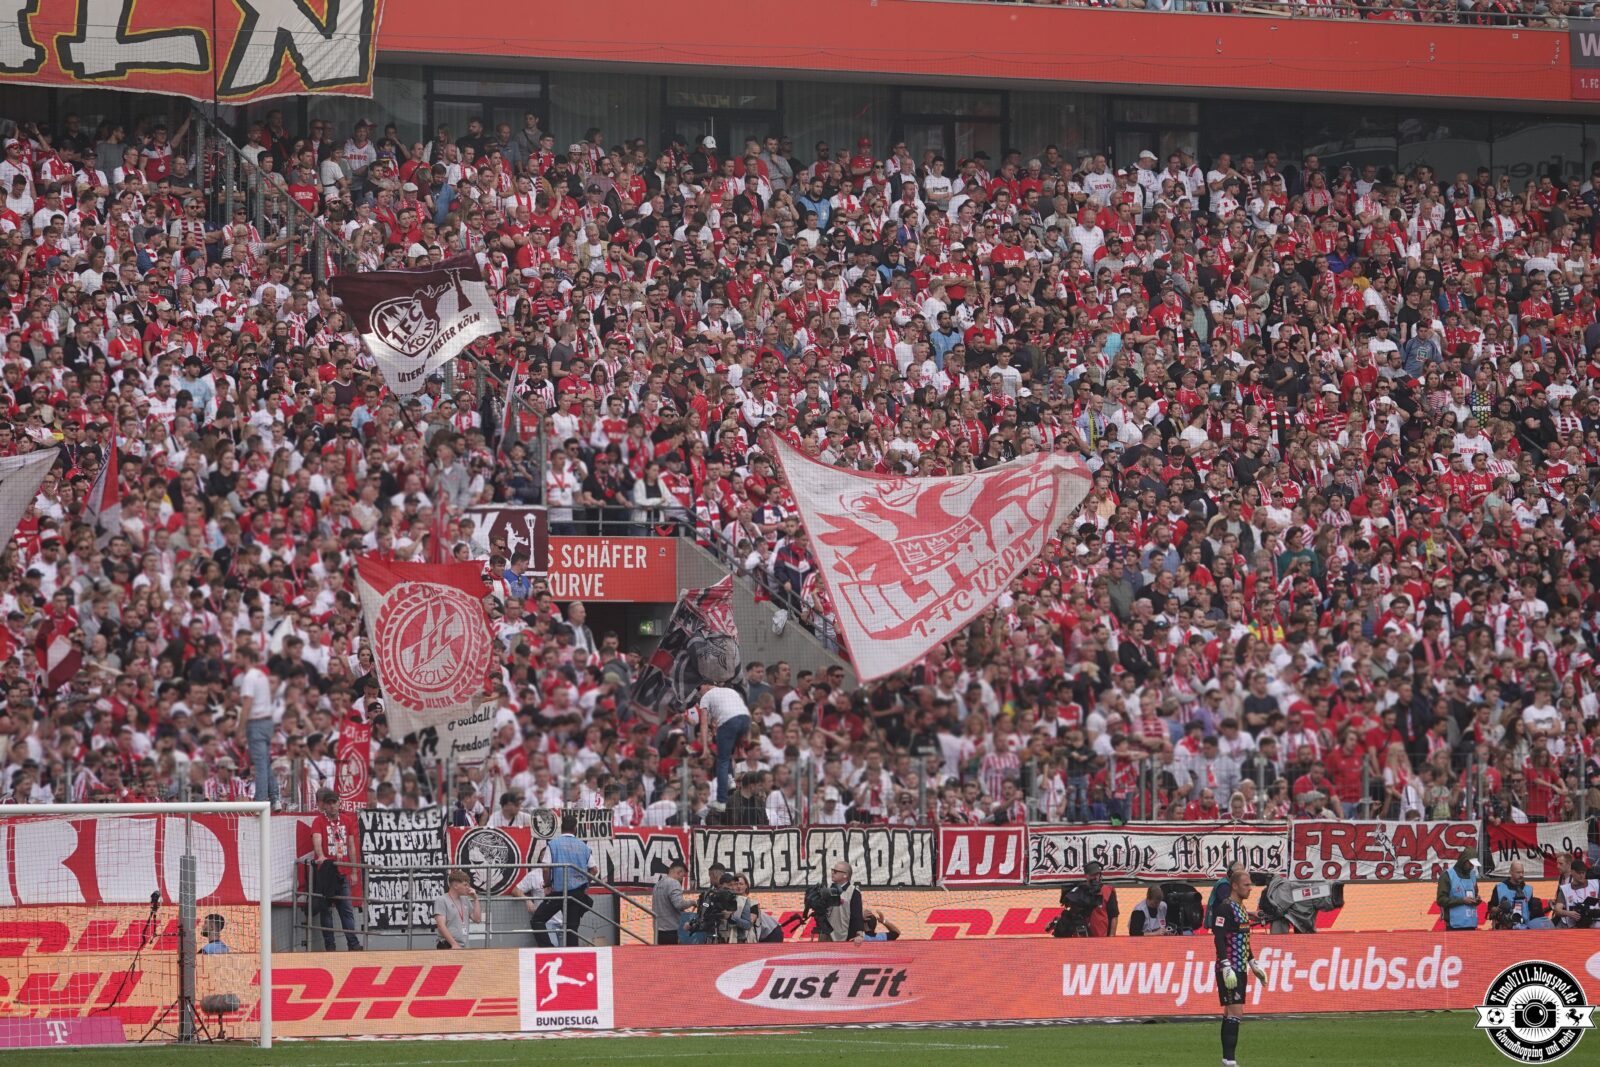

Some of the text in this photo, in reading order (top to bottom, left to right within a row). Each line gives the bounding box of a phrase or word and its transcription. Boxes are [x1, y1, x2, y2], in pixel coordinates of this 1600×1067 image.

[458, 312, 481, 331] KÖLN
[407, 320, 434, 352] KÖLN
[561, 540, 647, 568] SCHÄFER
[838, 500, 1033, 638] ULTRA
[450, 736, 490, 758] freedom
[360, 808, 442, 830] VIRAGE
[362, 830, 442, 851] AUTEUIL
[1294, 823, 1477, 861] FREAKS
[1498, 839, 1520, 862] NA
[946, 835, 1017, 875] AJJ
[1030, 834, 1283, 880] Kölsche Mythos
[1294, 861, 1448, 881] COLOGN
[368, 879, 445, 901] OSMOPLITES
[738, 967, 907, 1000] Just Fit
[1062, 945, 1463, 1006] www.jufit-clubs.de
[0, 970, 158, 1024] HL
[250, 965, 476, 1021] DHL
[47, 1020, 68, 1043] T
[536, 1016, 599, 1026] BUNDESLIGA
